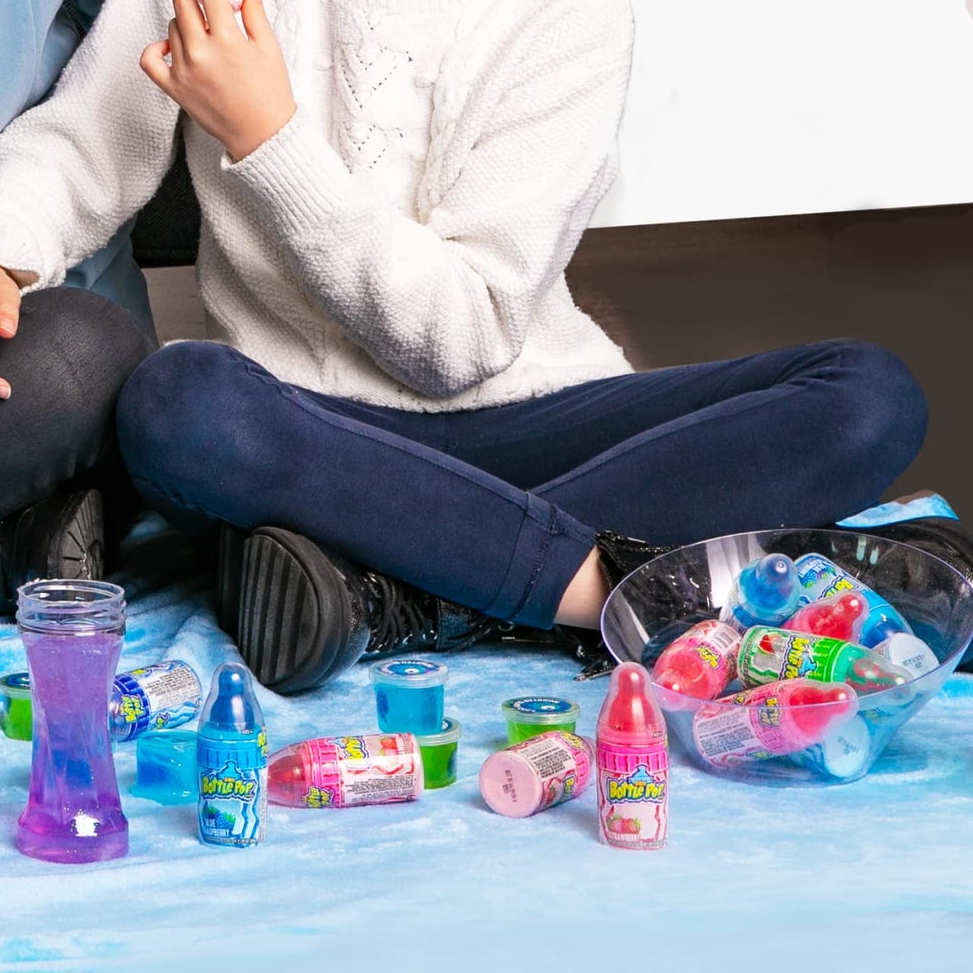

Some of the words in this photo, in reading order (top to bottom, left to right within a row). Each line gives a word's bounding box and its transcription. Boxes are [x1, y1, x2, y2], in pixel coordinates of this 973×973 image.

[202, 776, 234, 795] BOTTLE
[235, 780, 254, 795] POP
[609, 781, 644, 799] BOTTLE
